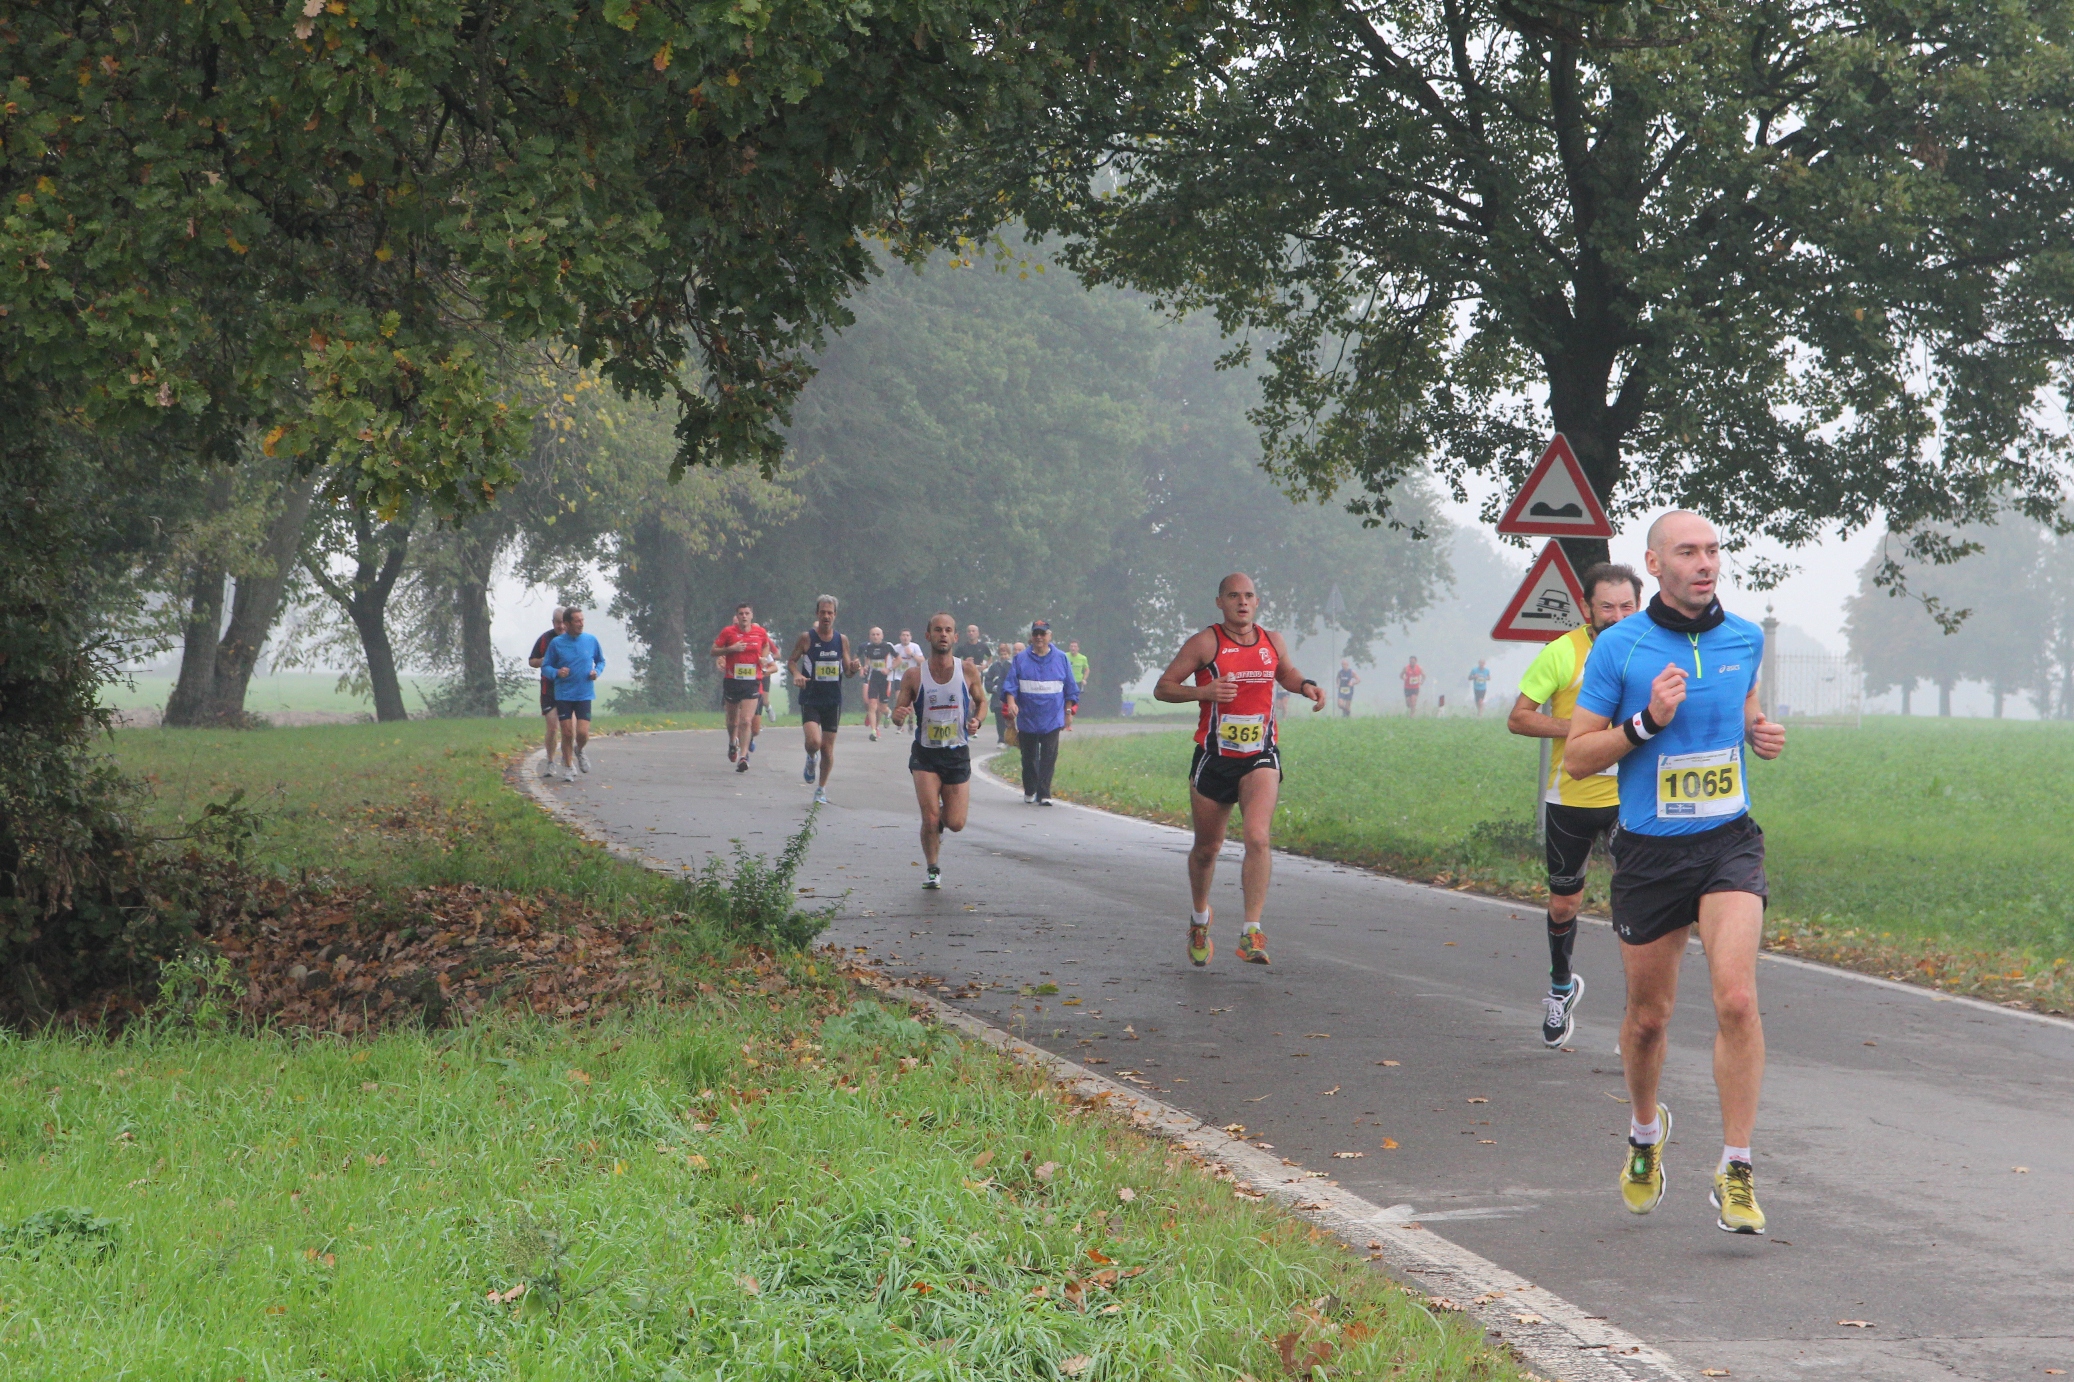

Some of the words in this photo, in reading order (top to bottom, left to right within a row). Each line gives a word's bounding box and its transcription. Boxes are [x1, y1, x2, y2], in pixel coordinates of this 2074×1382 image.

[821, 667, 836, 675] 104
[933, 726, 951, 738] 700
[1228, 725, 1259, 742] 365
[1665, 768, 1733, 798] 1065
